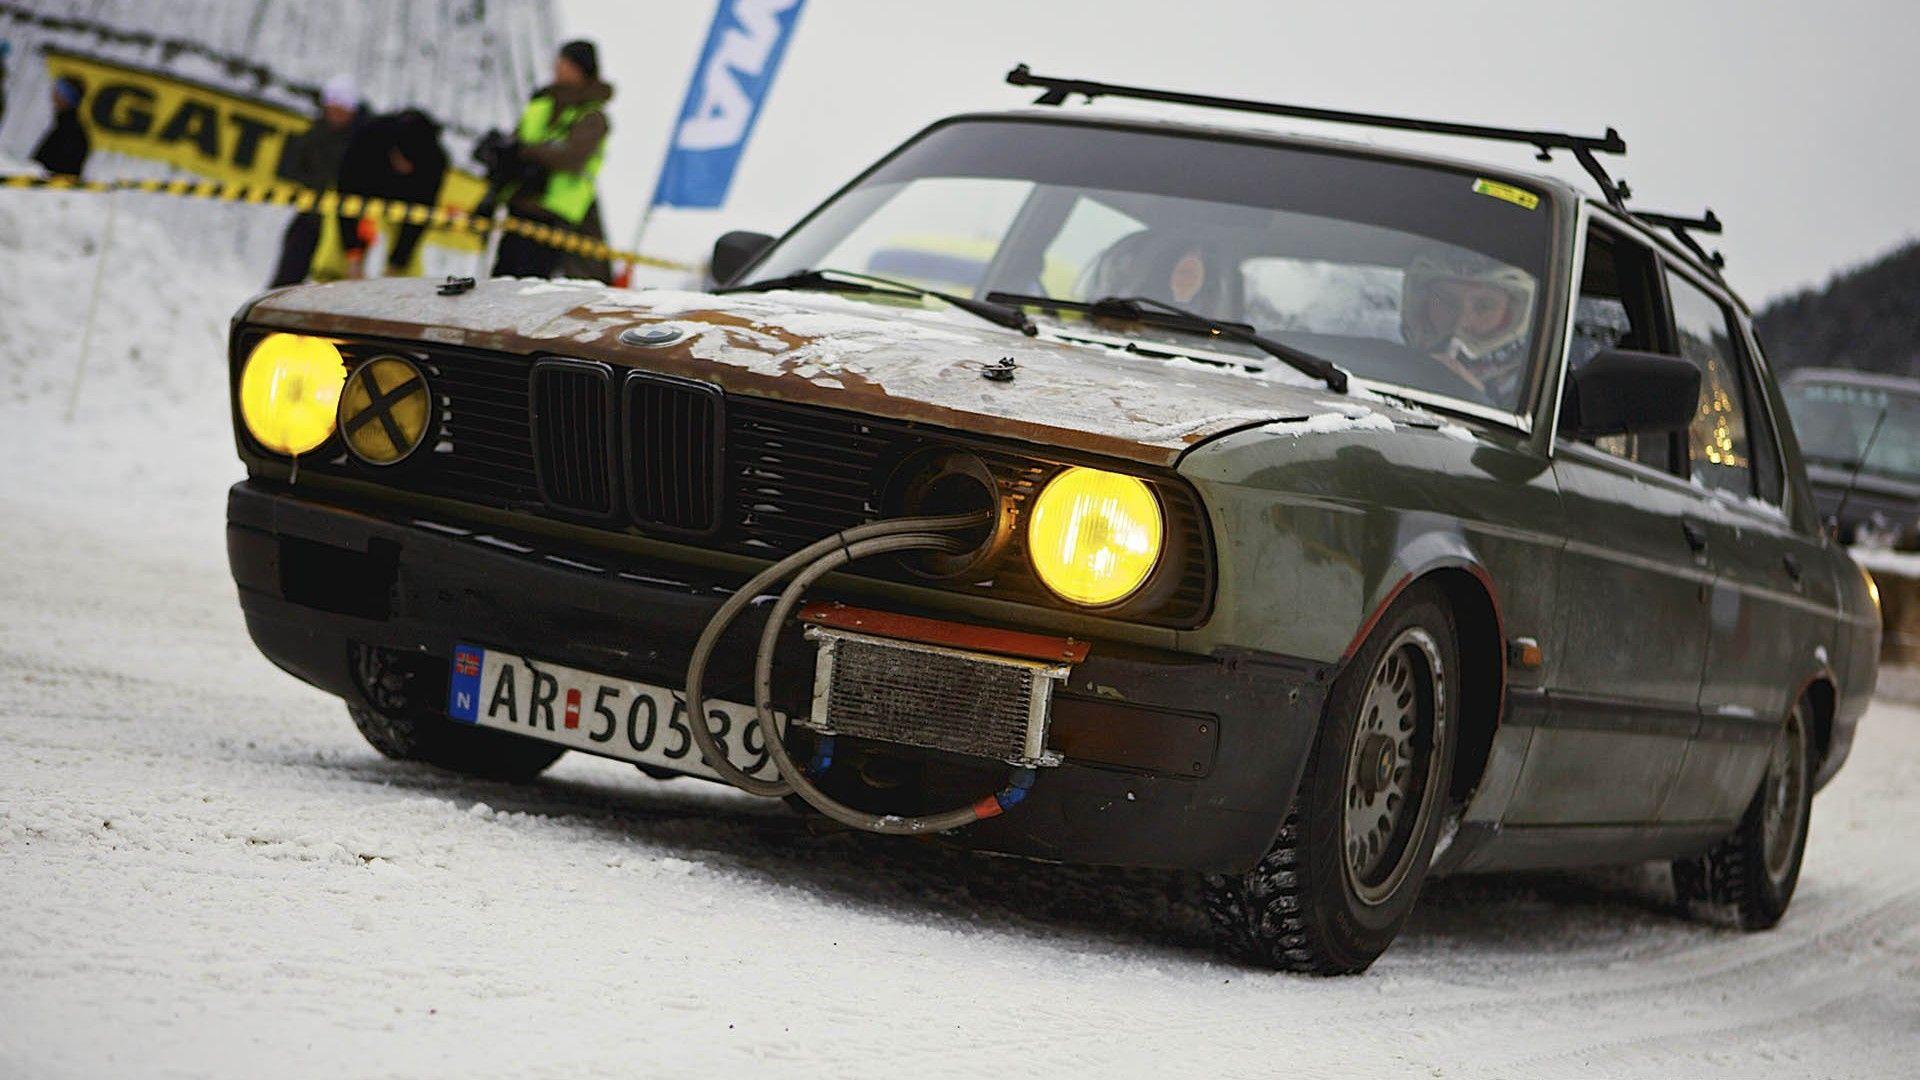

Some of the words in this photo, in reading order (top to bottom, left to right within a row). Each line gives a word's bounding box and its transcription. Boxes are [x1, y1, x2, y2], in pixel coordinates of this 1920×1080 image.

[72, 74, 304, 178] GAT
[457, 691, 471, 710] N
[488, 663, 559, 731] AR
[589, 685, 771, 775] 50539
